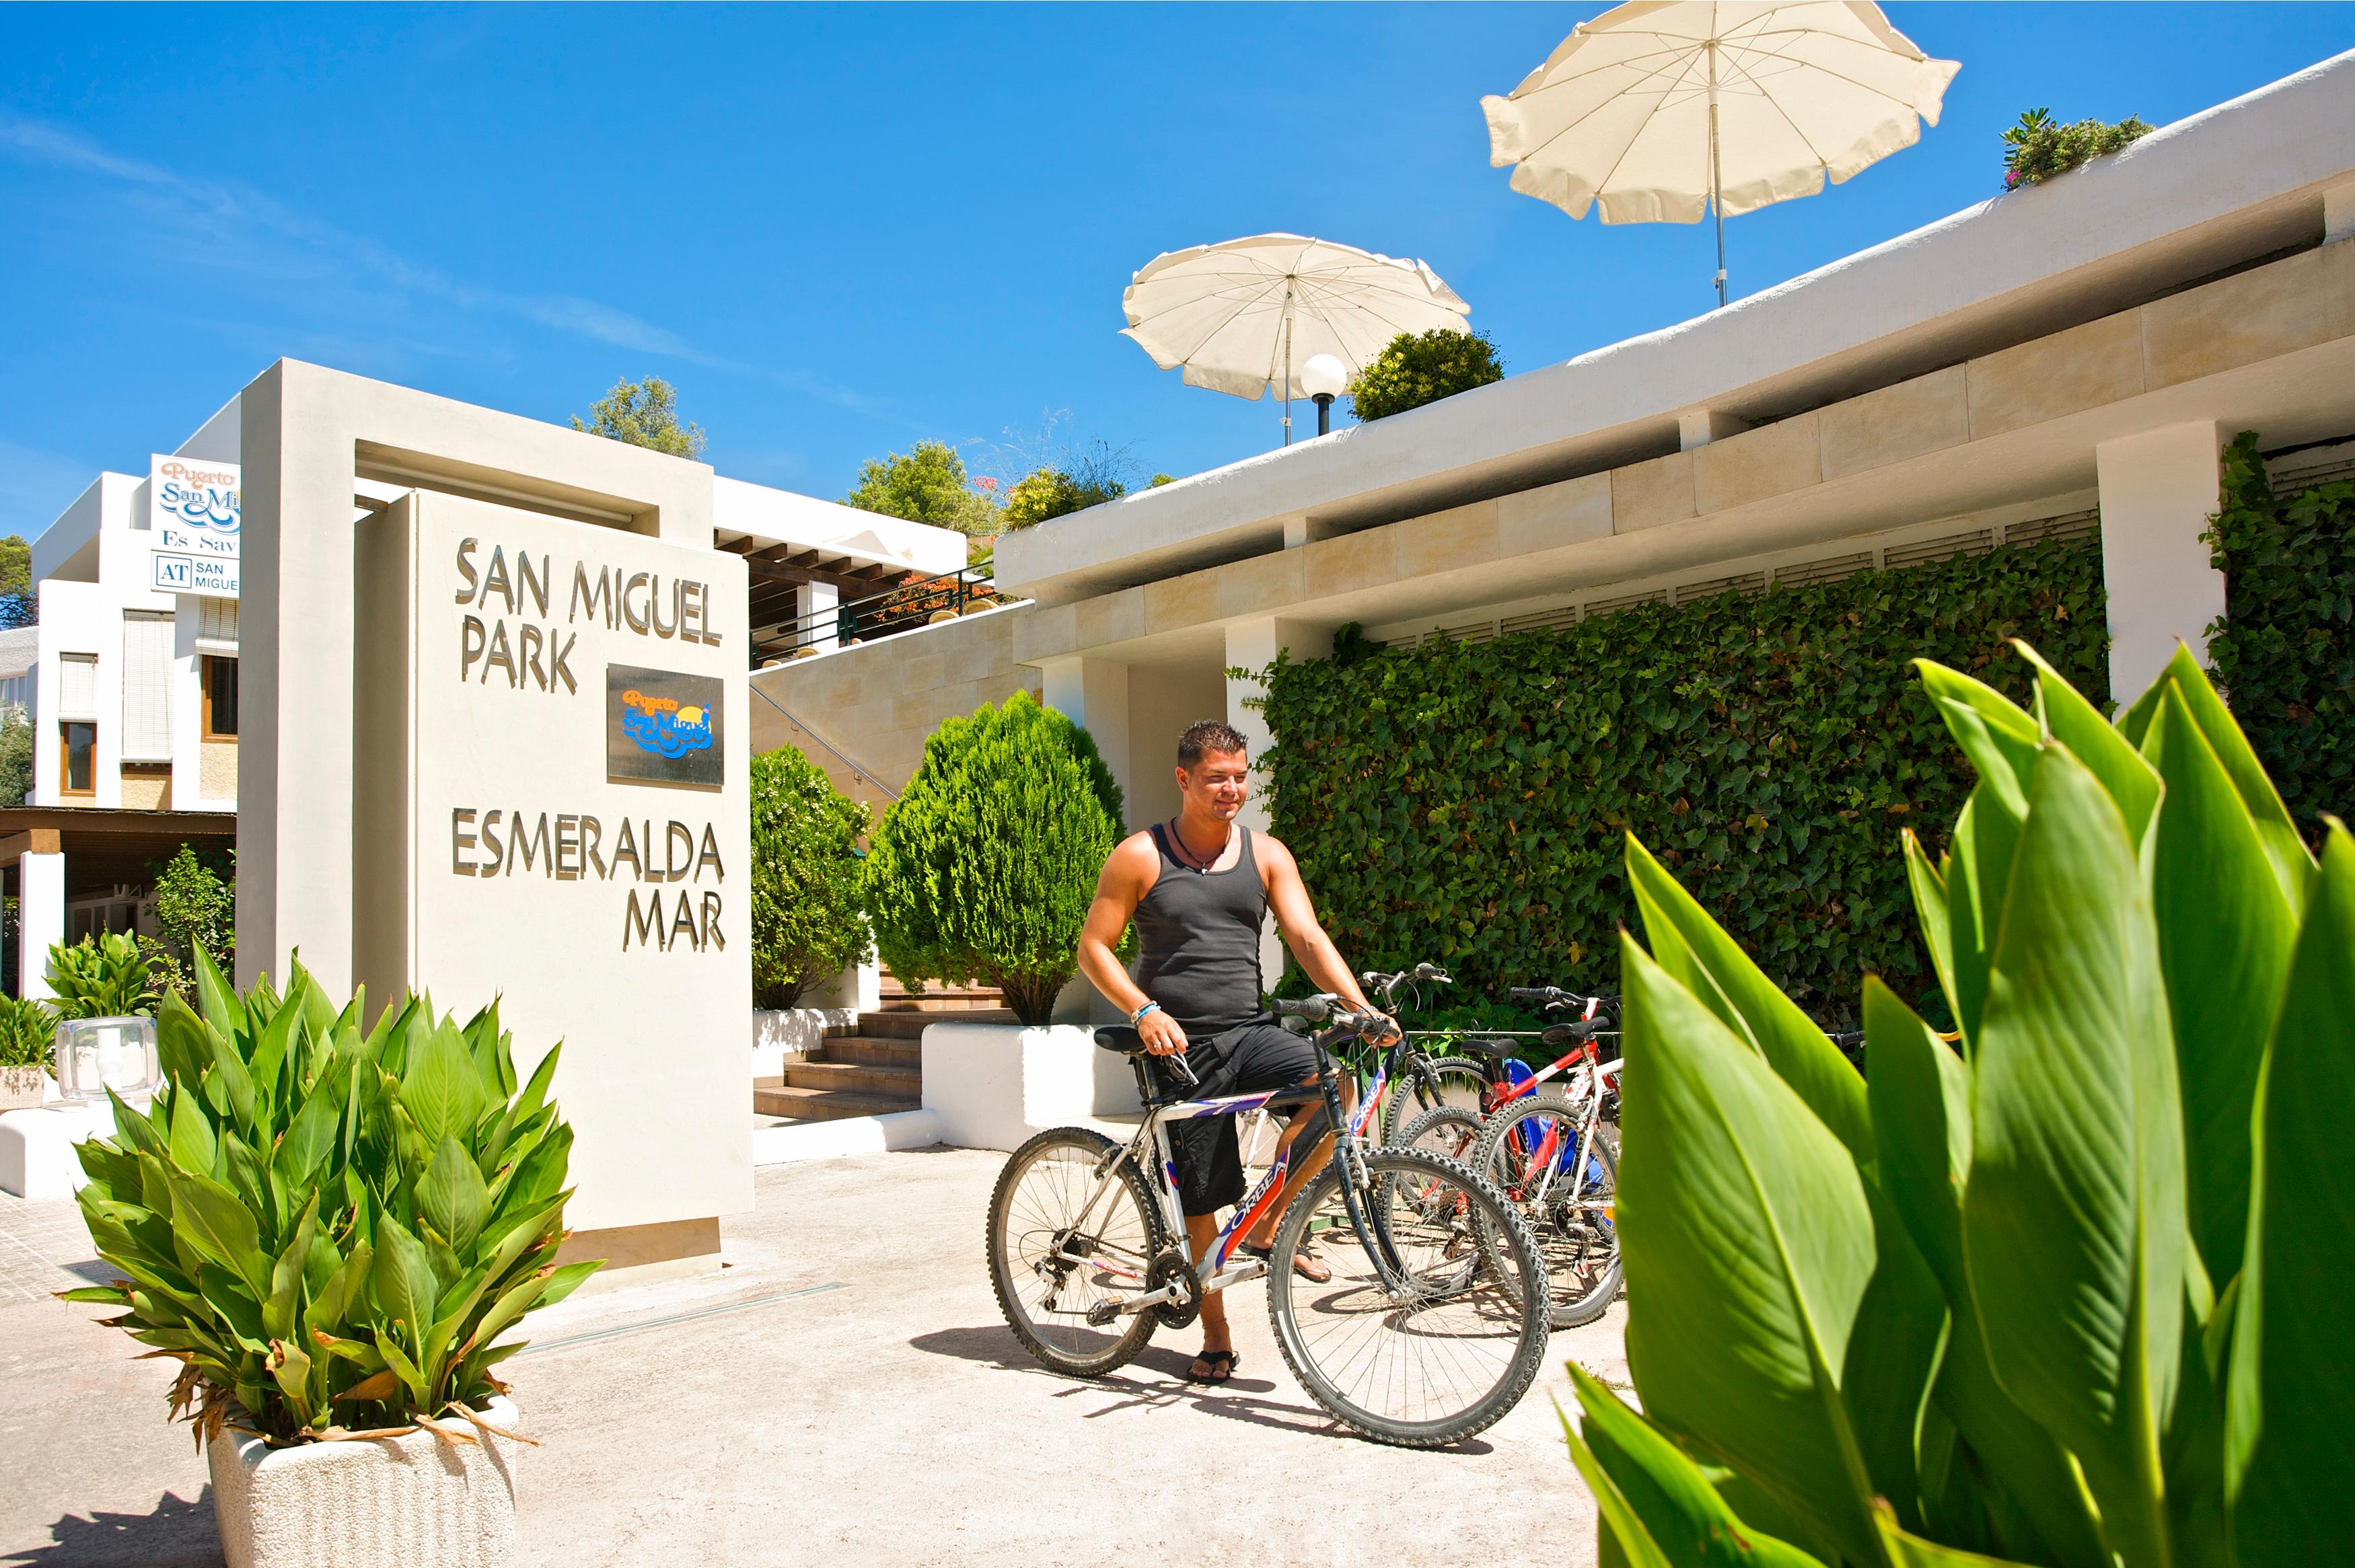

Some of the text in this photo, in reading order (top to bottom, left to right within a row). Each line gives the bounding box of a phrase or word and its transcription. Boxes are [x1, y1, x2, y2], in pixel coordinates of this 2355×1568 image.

[161, 462, 236, 490] Puerto
[160, 482, 240, 510] San Mi
[162, 529, 188, 548] Es
[161, 564, 189, 582] AT
[196, 562, 223, 574] SAN
[196, 576, 238, 591] MIGUE
[456, 537, 723, 643] SAN MIGUEL
[463, 613, 578, 692] PARK
[622, 689, 678, 716] Puerto
[453, 807, 725, 881] ESMERALDA
[624, 888, 726, 949] MAR
[1354, 1078, 1385, 1131] ORBEA
[1231, 1161, 1287, 1230] ORBEA
